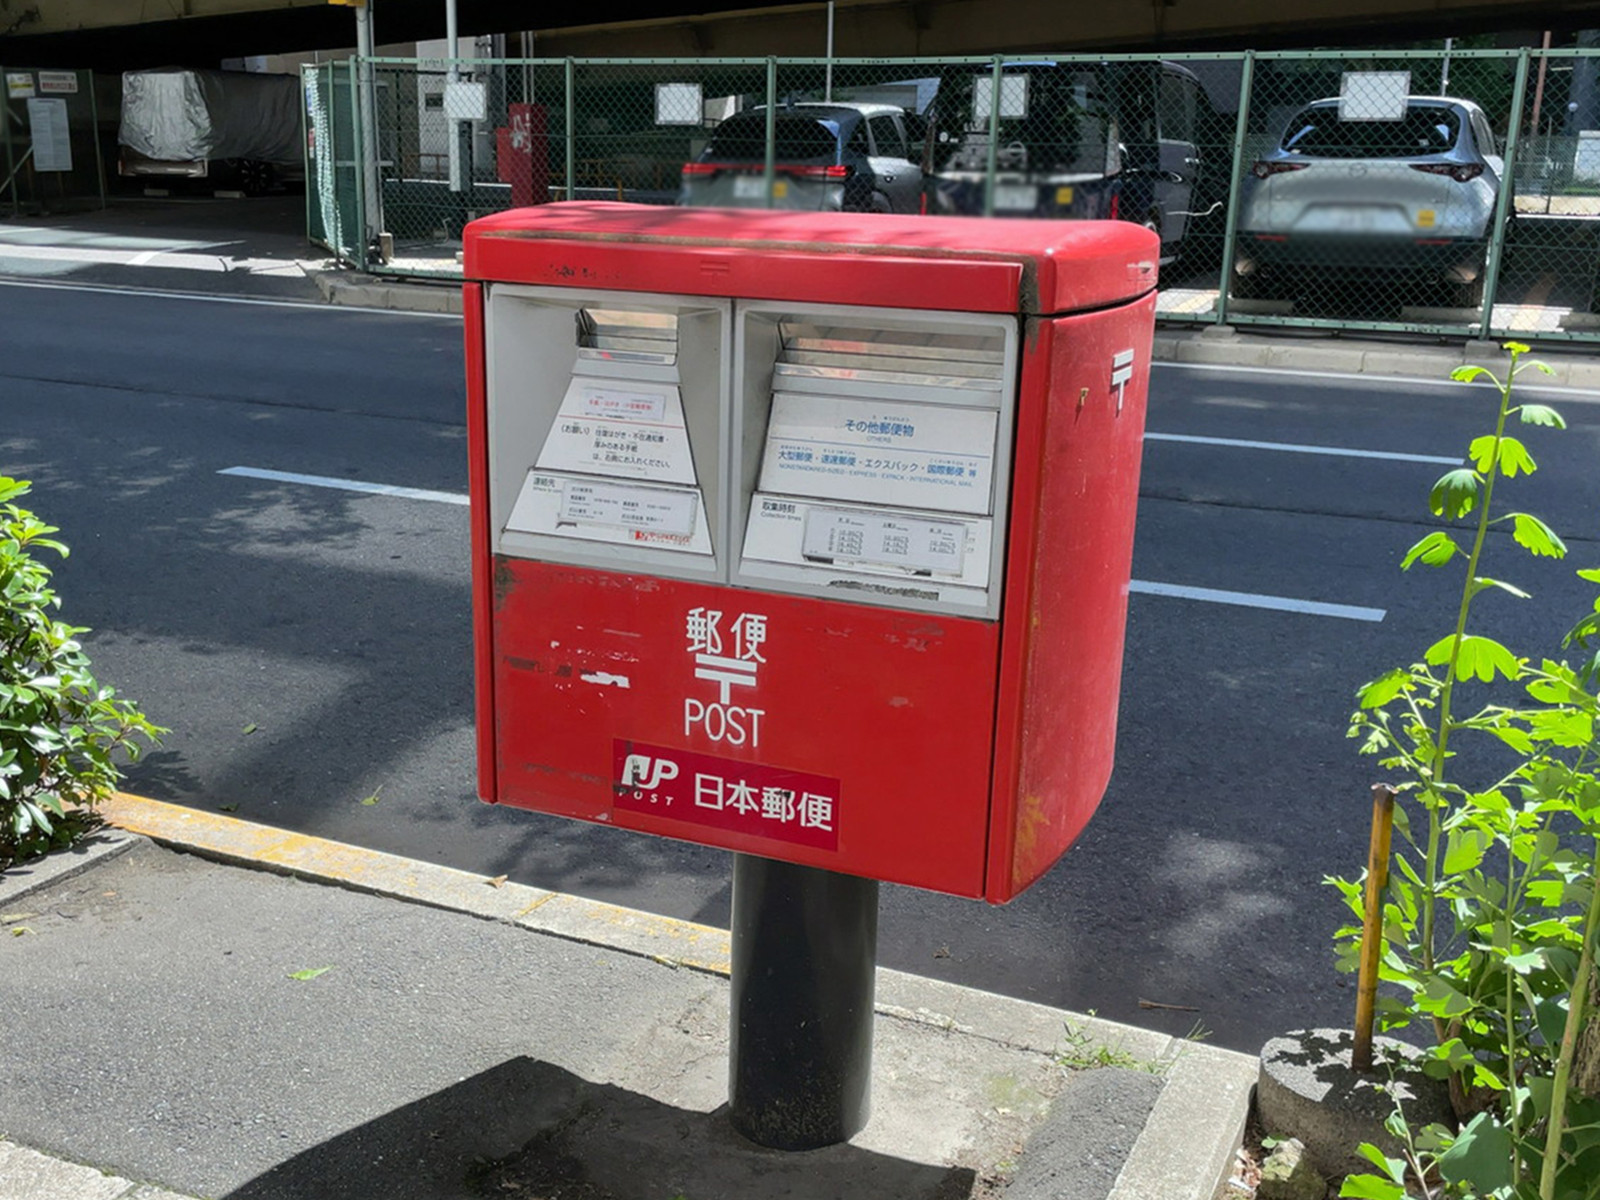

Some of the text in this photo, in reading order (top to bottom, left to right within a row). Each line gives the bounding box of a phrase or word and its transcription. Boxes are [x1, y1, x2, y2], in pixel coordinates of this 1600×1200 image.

[845, 418, 915, 438] その他郵便物
[762, 501, 796, 514] 取集時刻
[686, 607, 768, 664] 郵便
[684, 698, 765, 748] POST
[694, 772, 833, 832] 日本郵便
